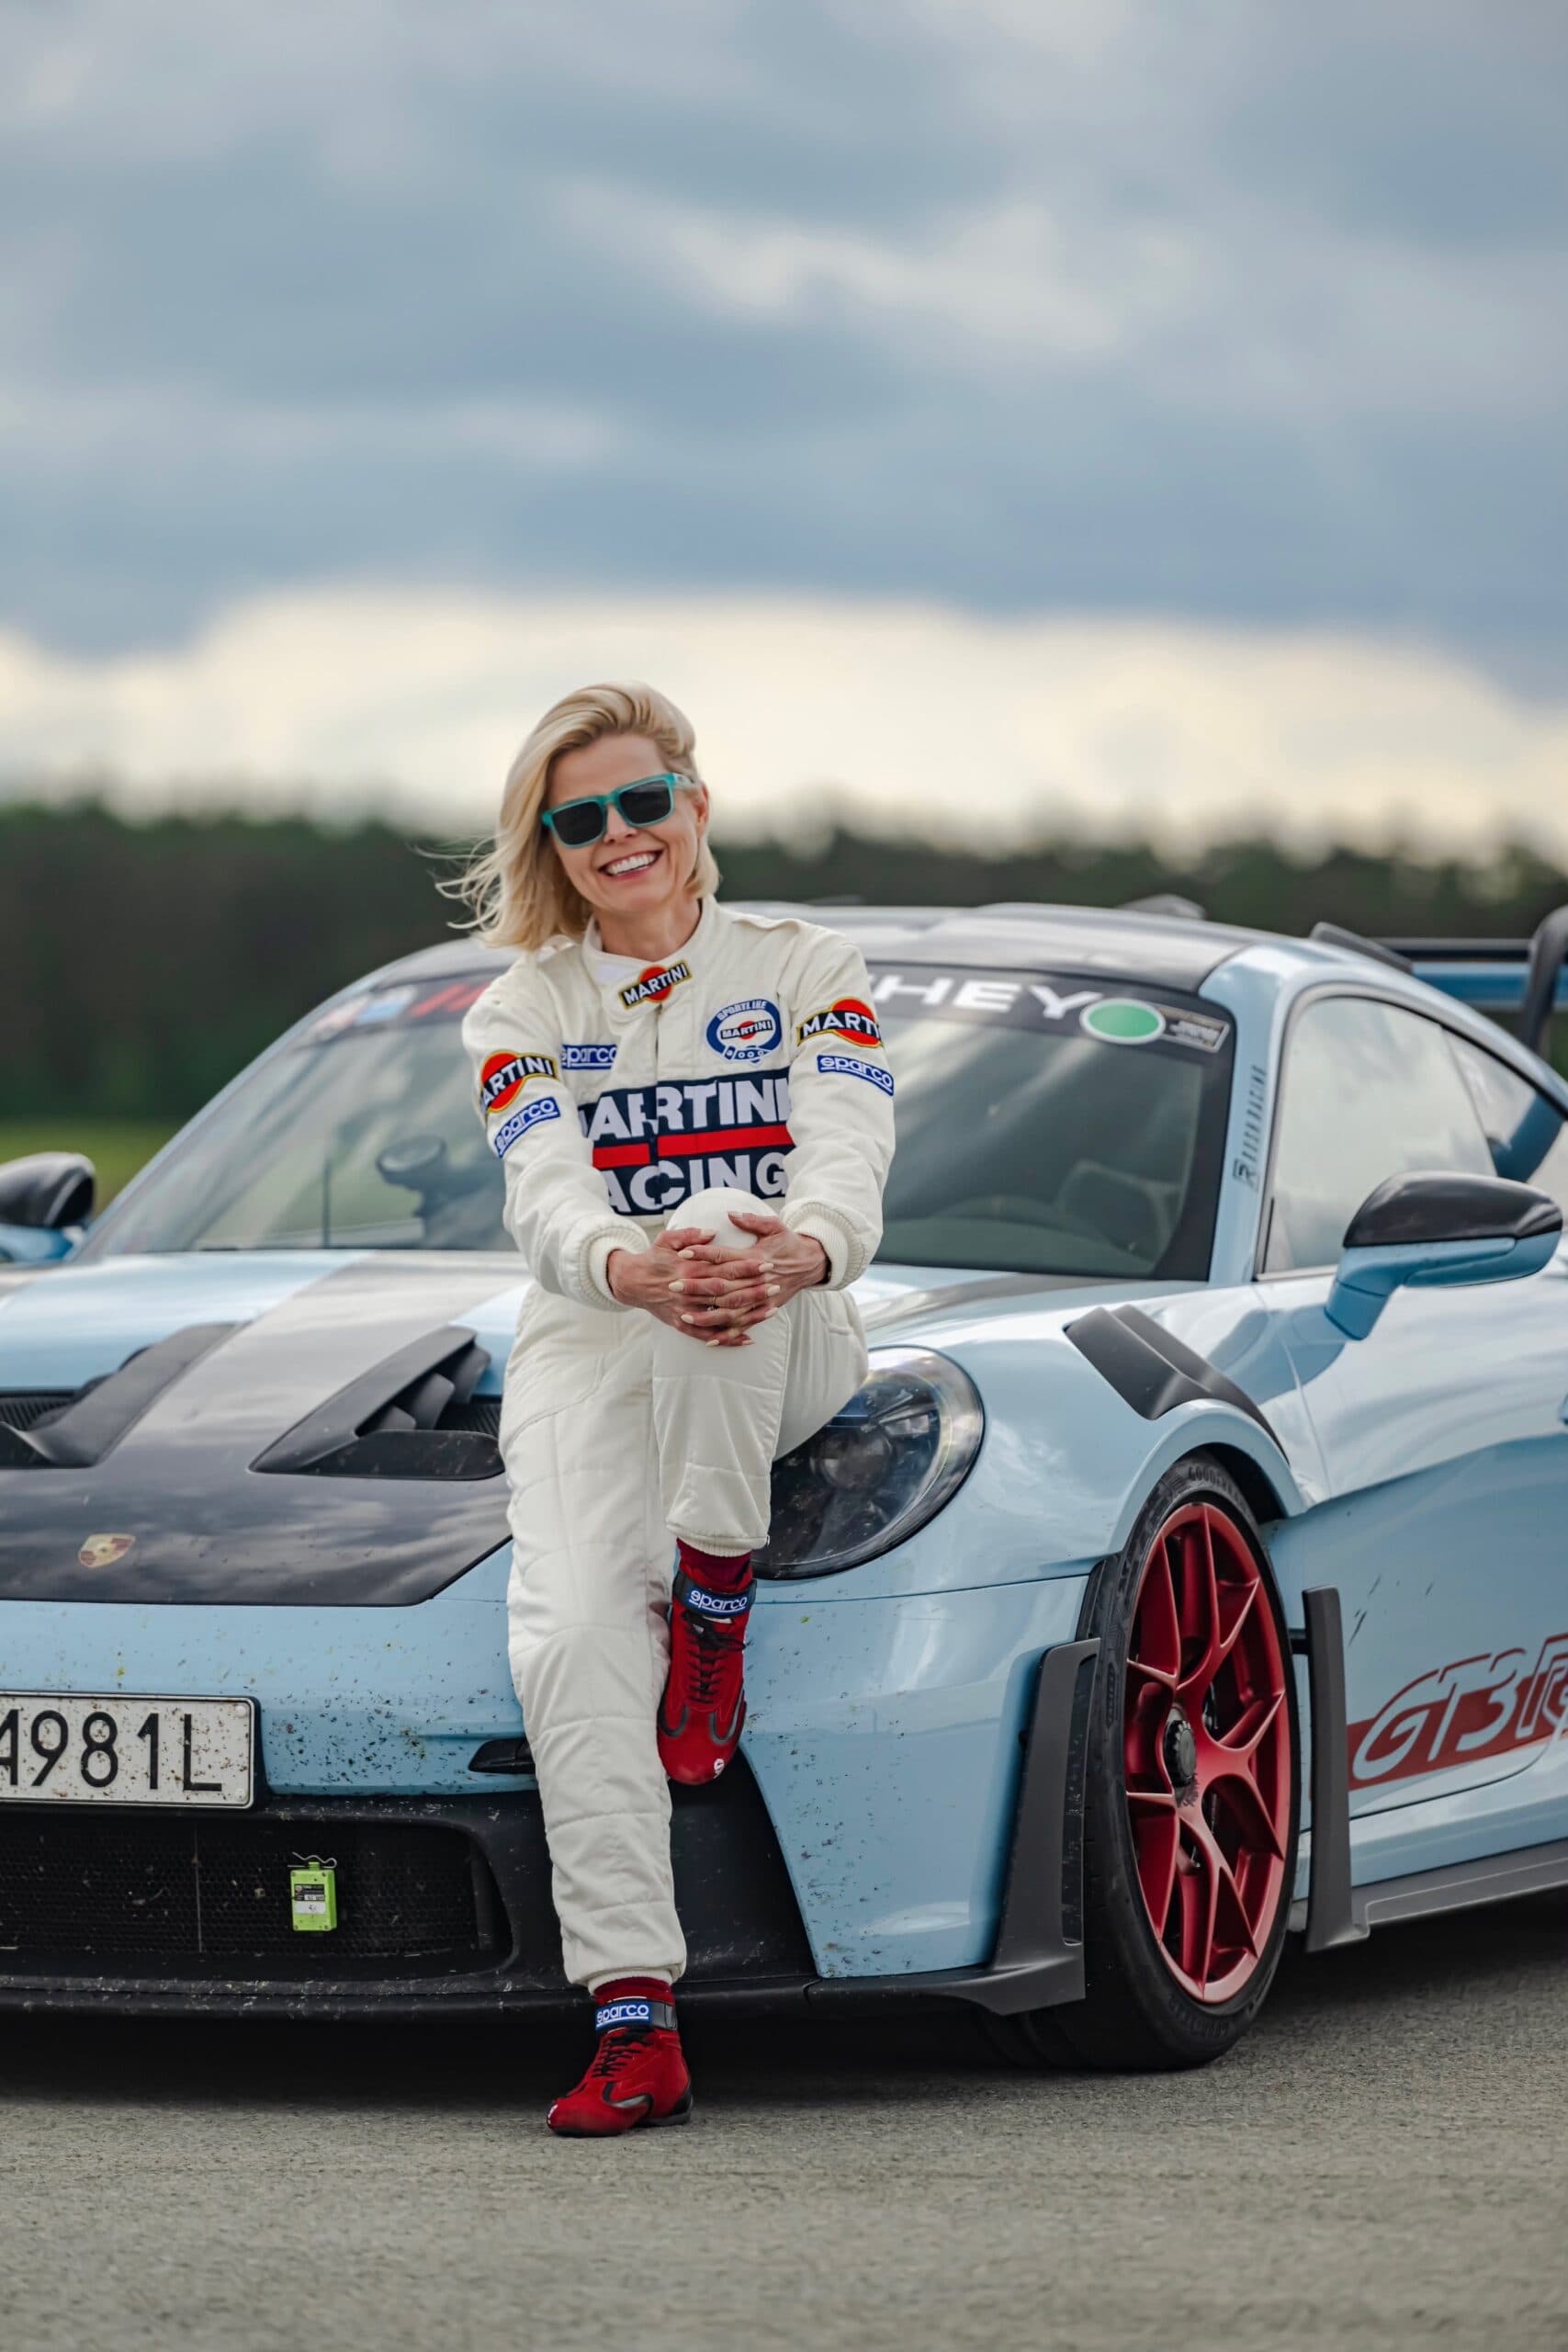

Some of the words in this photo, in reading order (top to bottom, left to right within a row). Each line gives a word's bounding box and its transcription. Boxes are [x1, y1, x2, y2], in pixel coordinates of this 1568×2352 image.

[624, 964, 688, 1005] MARTINI
[869, 974, 1103, 1020] HEY
[721, 1020, 773, 1038] MARTINI
[481, 1057, 554, 1109] ARTINI
[820, 1057, 893, 1089] sparco
[496, 1100, 555, 1149] sparco
[578, 1078, 791, 1140] ARTINI
[602, 1152, 789, 1213] ACING
[689, 1589, 748, 1611] sparco
[596, 2004, 649, 2024] sparco
